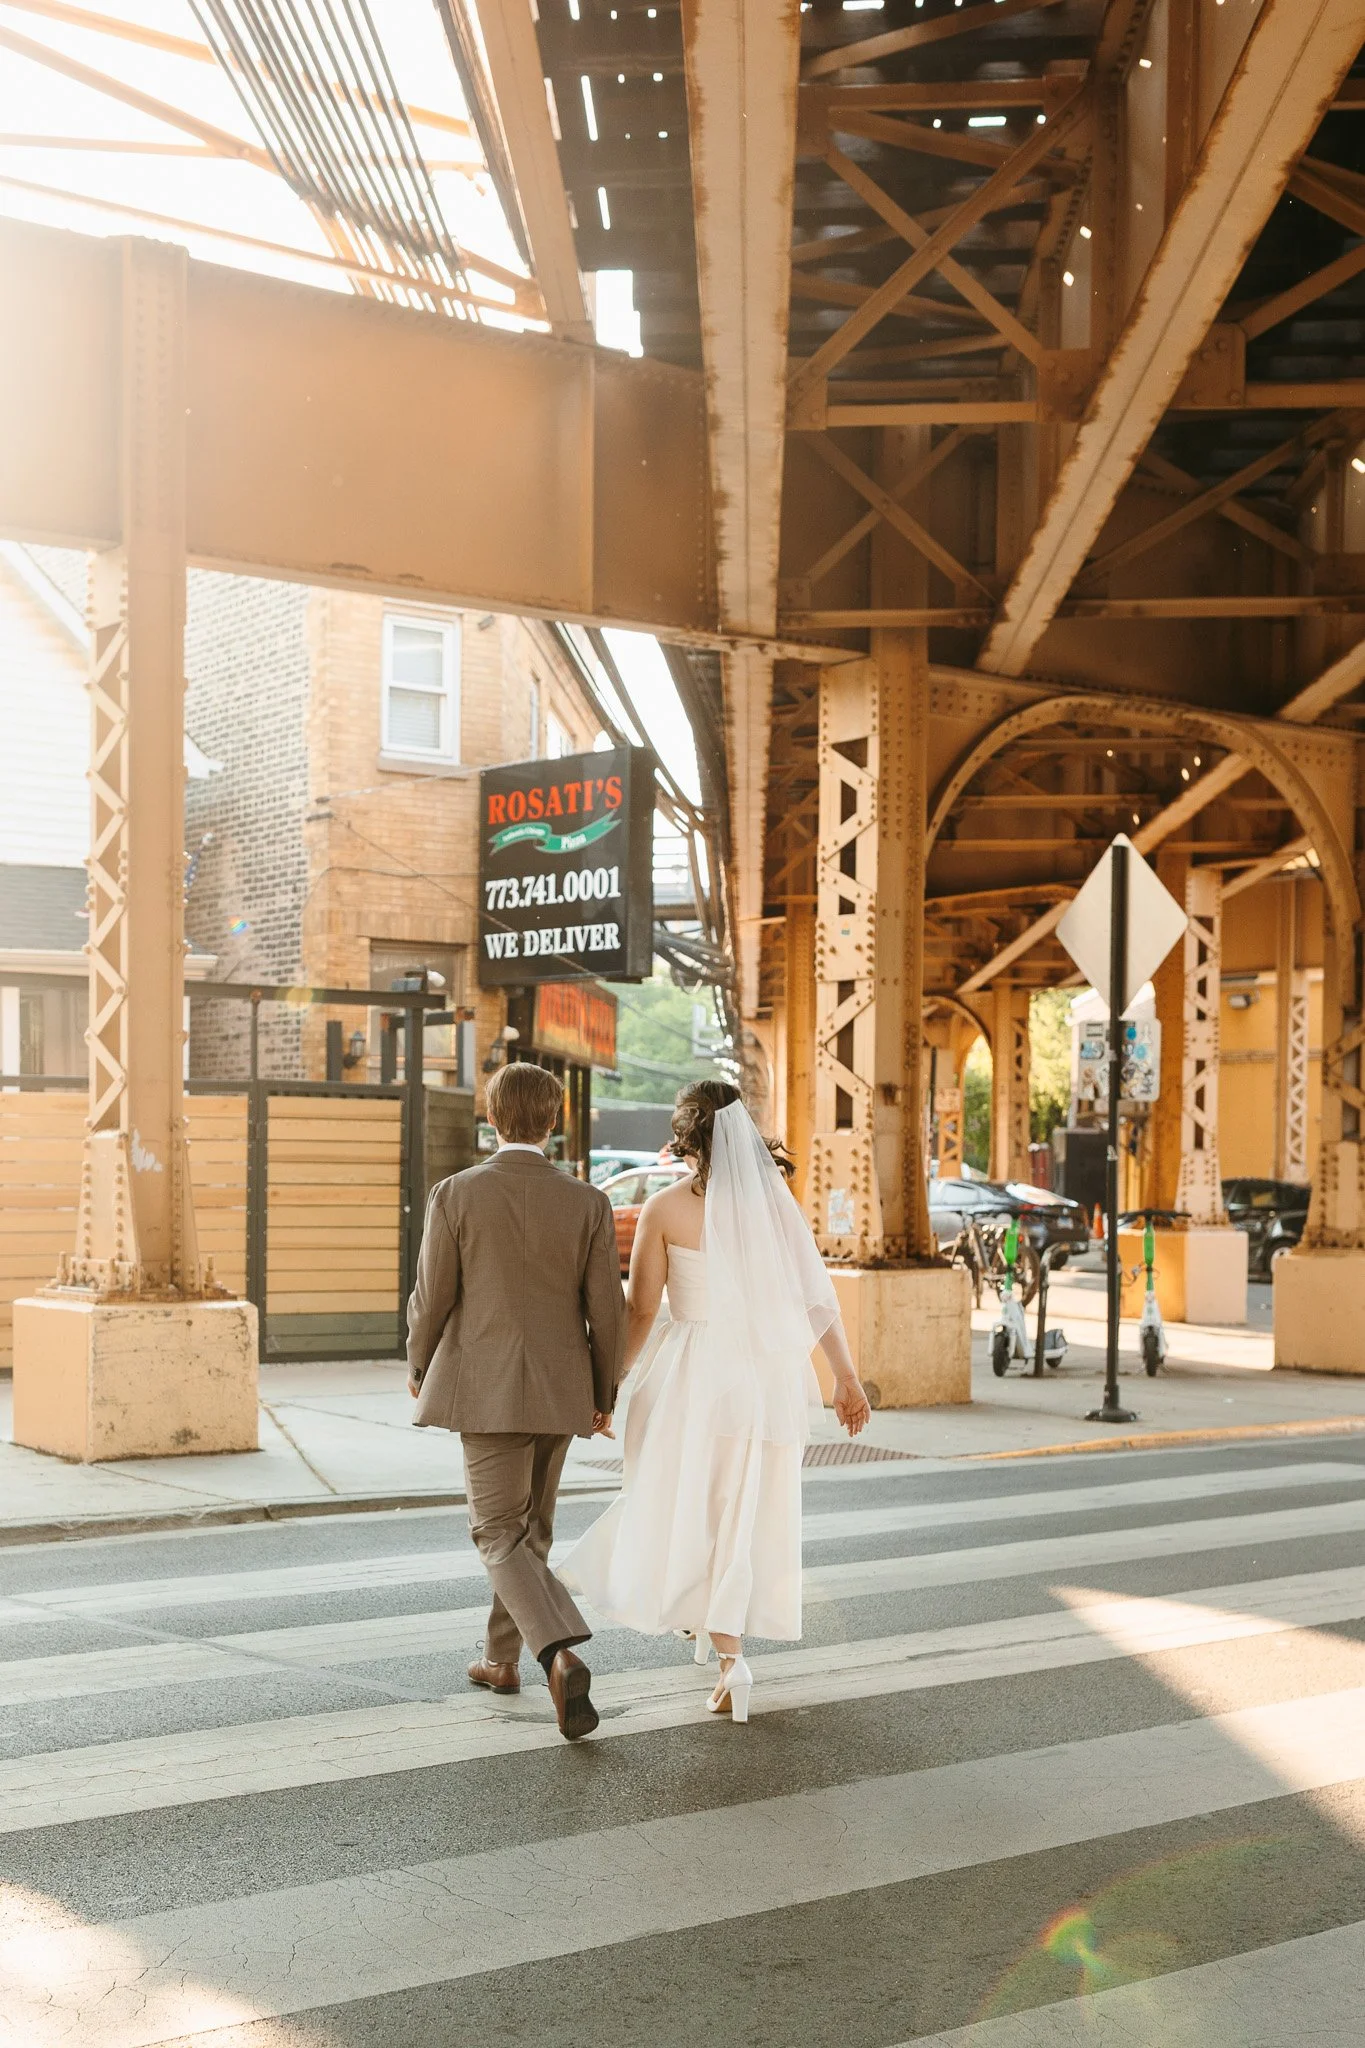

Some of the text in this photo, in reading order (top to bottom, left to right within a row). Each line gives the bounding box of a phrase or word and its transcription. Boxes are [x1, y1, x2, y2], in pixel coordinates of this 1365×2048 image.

[488, 776, 623, 825] ROSATI'S
[485, 866, 621, 911] 773.741.0001
[484, 923, 621, 960] WE DELIVER
